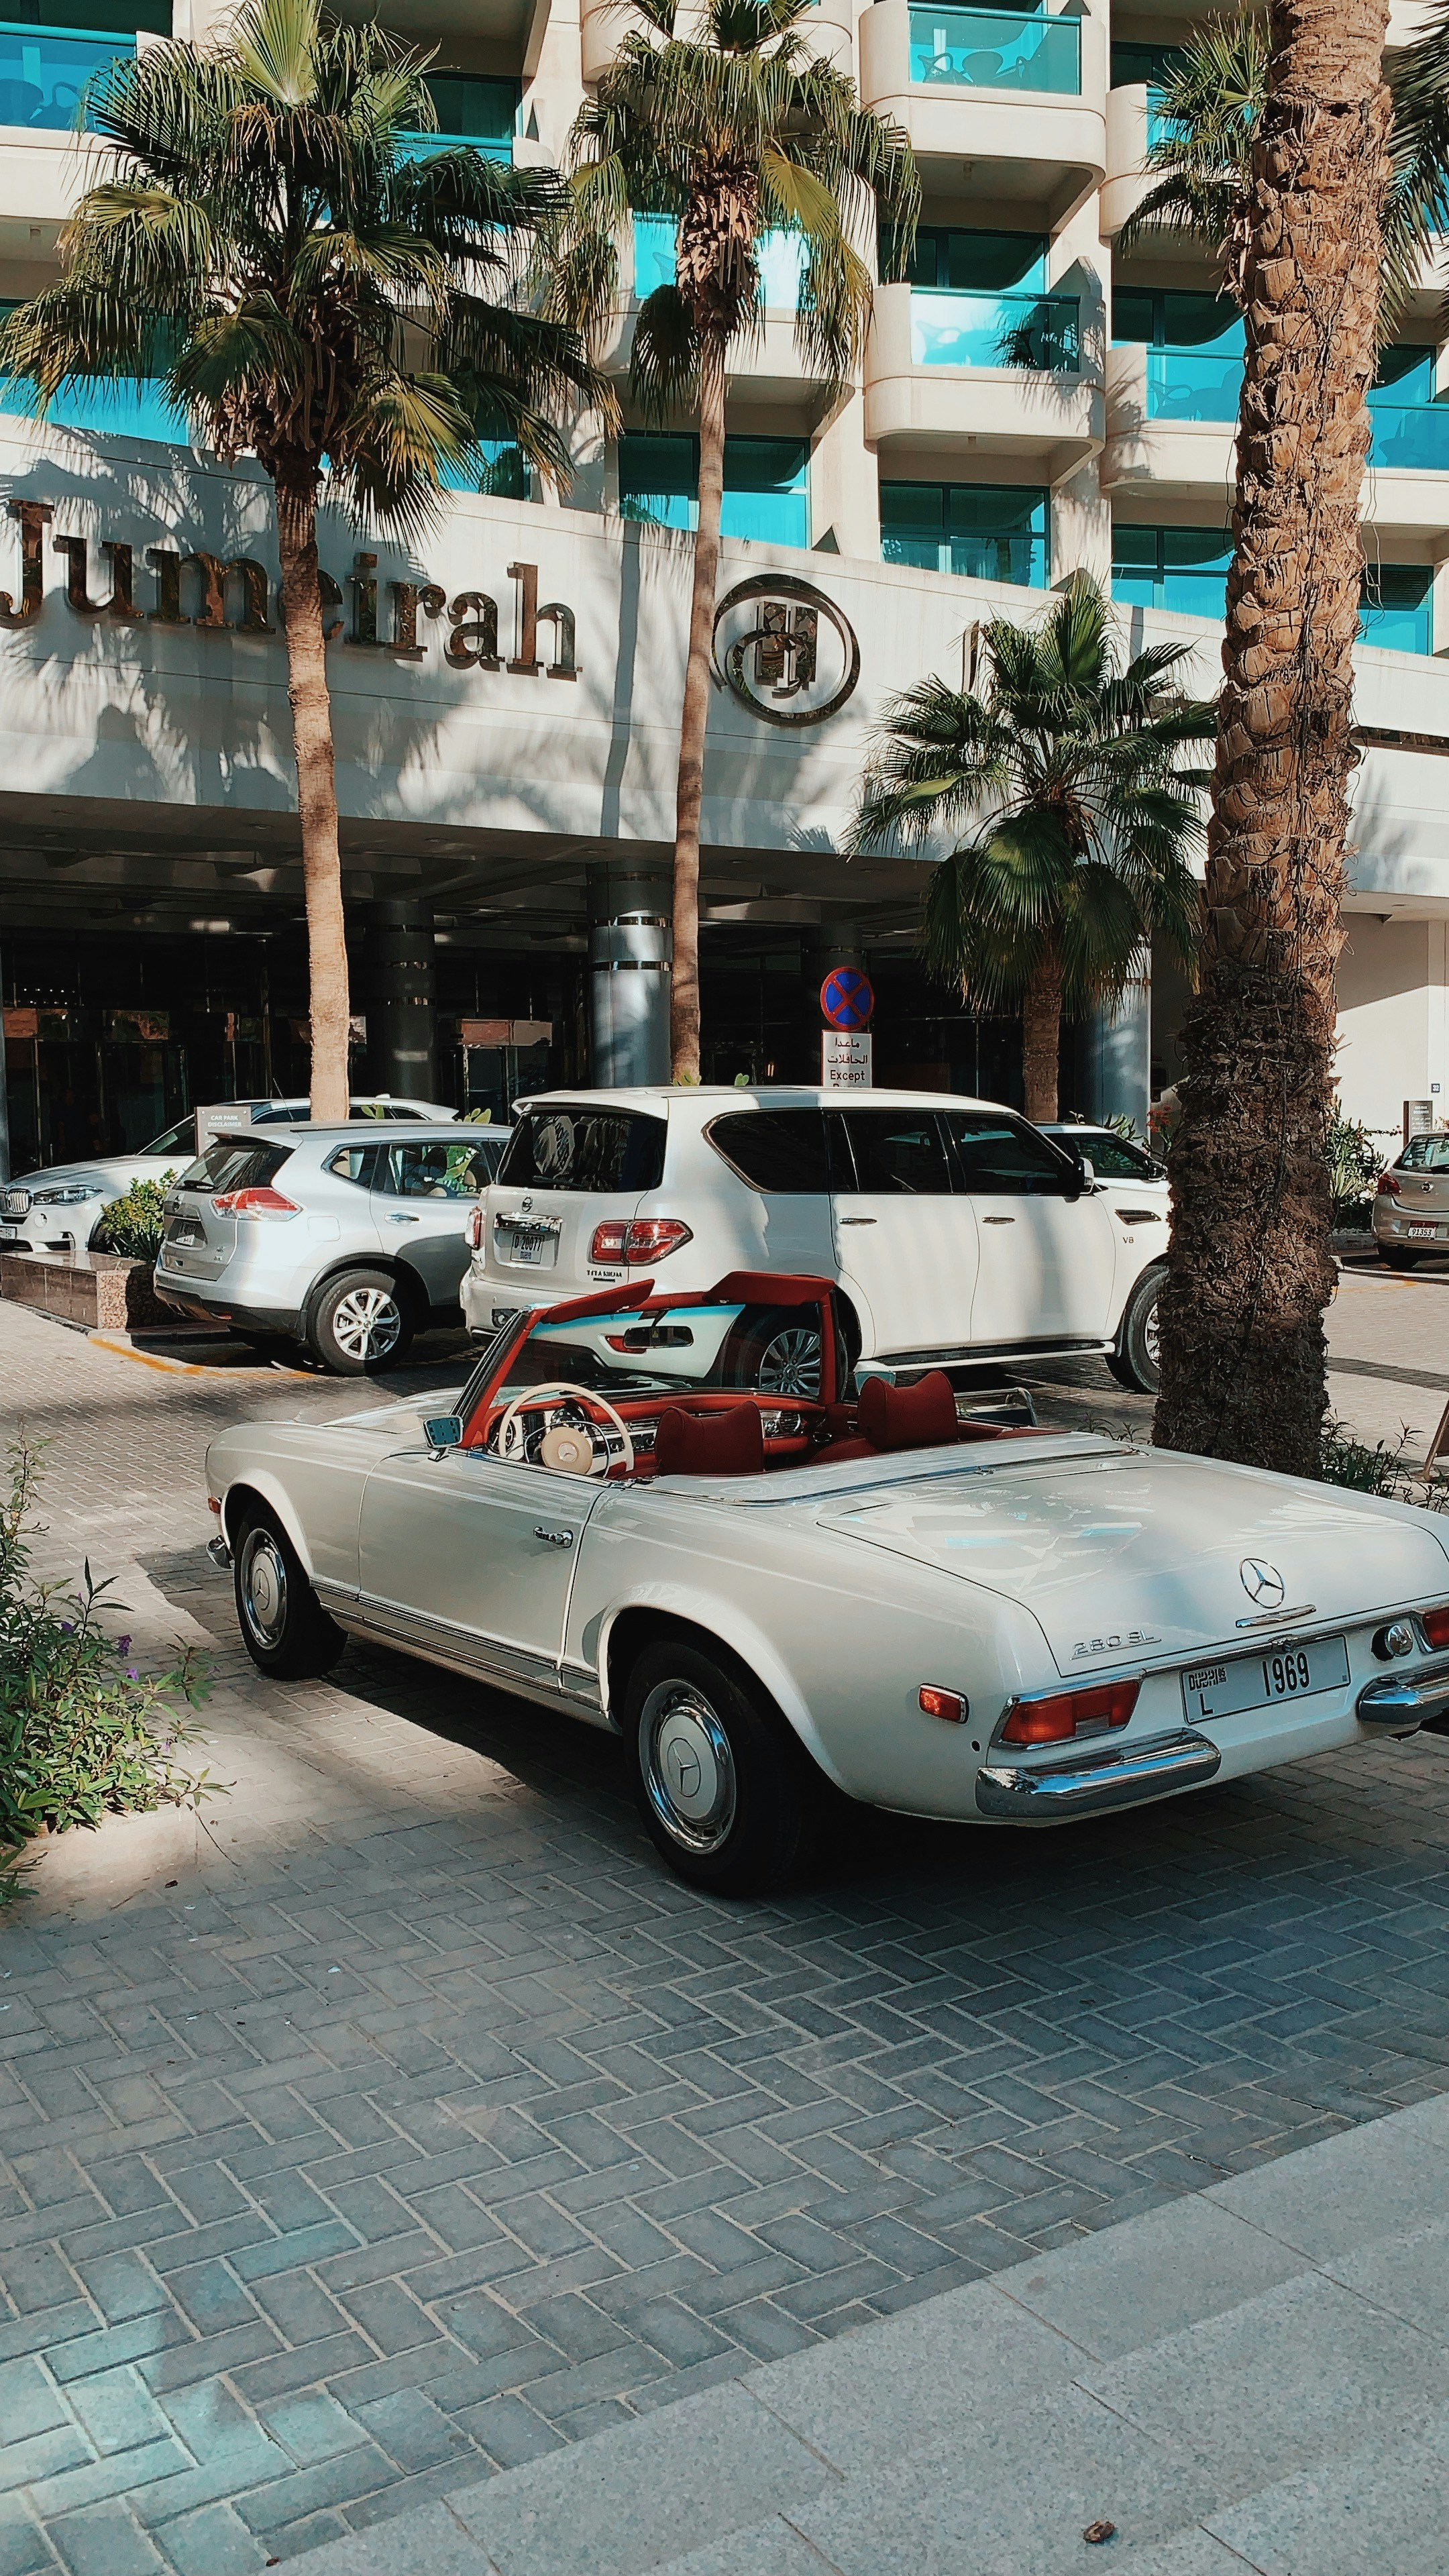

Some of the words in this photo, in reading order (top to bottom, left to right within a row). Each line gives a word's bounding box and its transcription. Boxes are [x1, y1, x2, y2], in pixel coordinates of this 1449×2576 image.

[827, 1053, 868, 1064] الحافلات
[830, 1069, 865, 1083] Except
[1412, 1228, 1432, 1236] 91353
[514, 1235, 520, 1248] D
[521, 1236, 542, 1251] 20077
[1073, 1635, 1122, 1656] 280
[1126, 1629, 1155, 1644] SL
[1262, 1652, 1309, 1697] 1969
[1199, 1693, 1214, 1716] L
